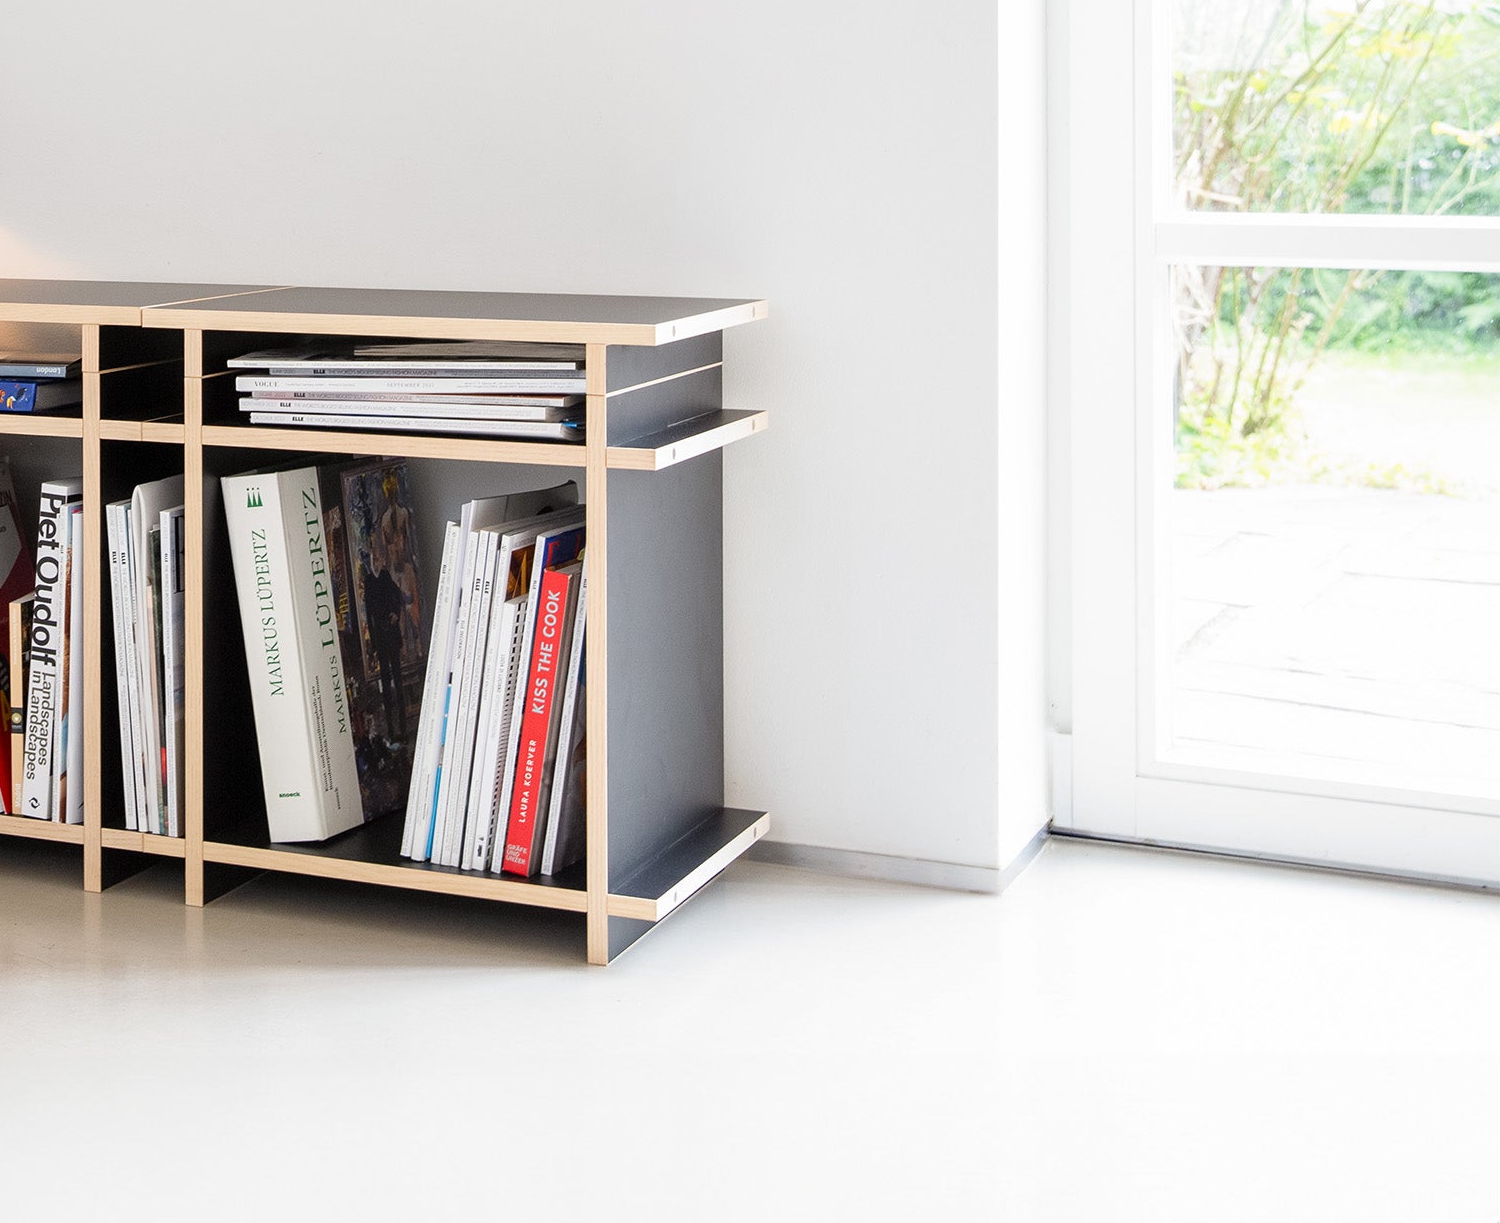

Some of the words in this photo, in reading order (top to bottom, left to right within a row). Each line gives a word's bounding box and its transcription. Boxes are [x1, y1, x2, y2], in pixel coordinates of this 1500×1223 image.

[36, 366, 61, 374] London
[38, 492, 66, 550] Piet
[252, 529, 274, 612] LÜPERTZ
[302, 487, 336, 651] LÜPERTZ
[30, 556, 59, 668] Oudolf
[542, 590, 560, 638] COOK
[32, 670, 41, 684] in
[262, 616, 285, 696] MARKUS
[537, 641, 554, 672] THE
[330, 655, 348, 733] MARKUS
[532, 678, 548, 714] KISS
[24, 686, 40, 780] Landscapes
[38, 672, 56, 766] Landscapes
[524, 740, 537, 787] KOERVER
[518, 791, 530, 823] LAURA
[506, 850, 520, 858] UND
[506, 856, 526, 865] UNZER
[507, 844, 528, 854] GRÄFE
